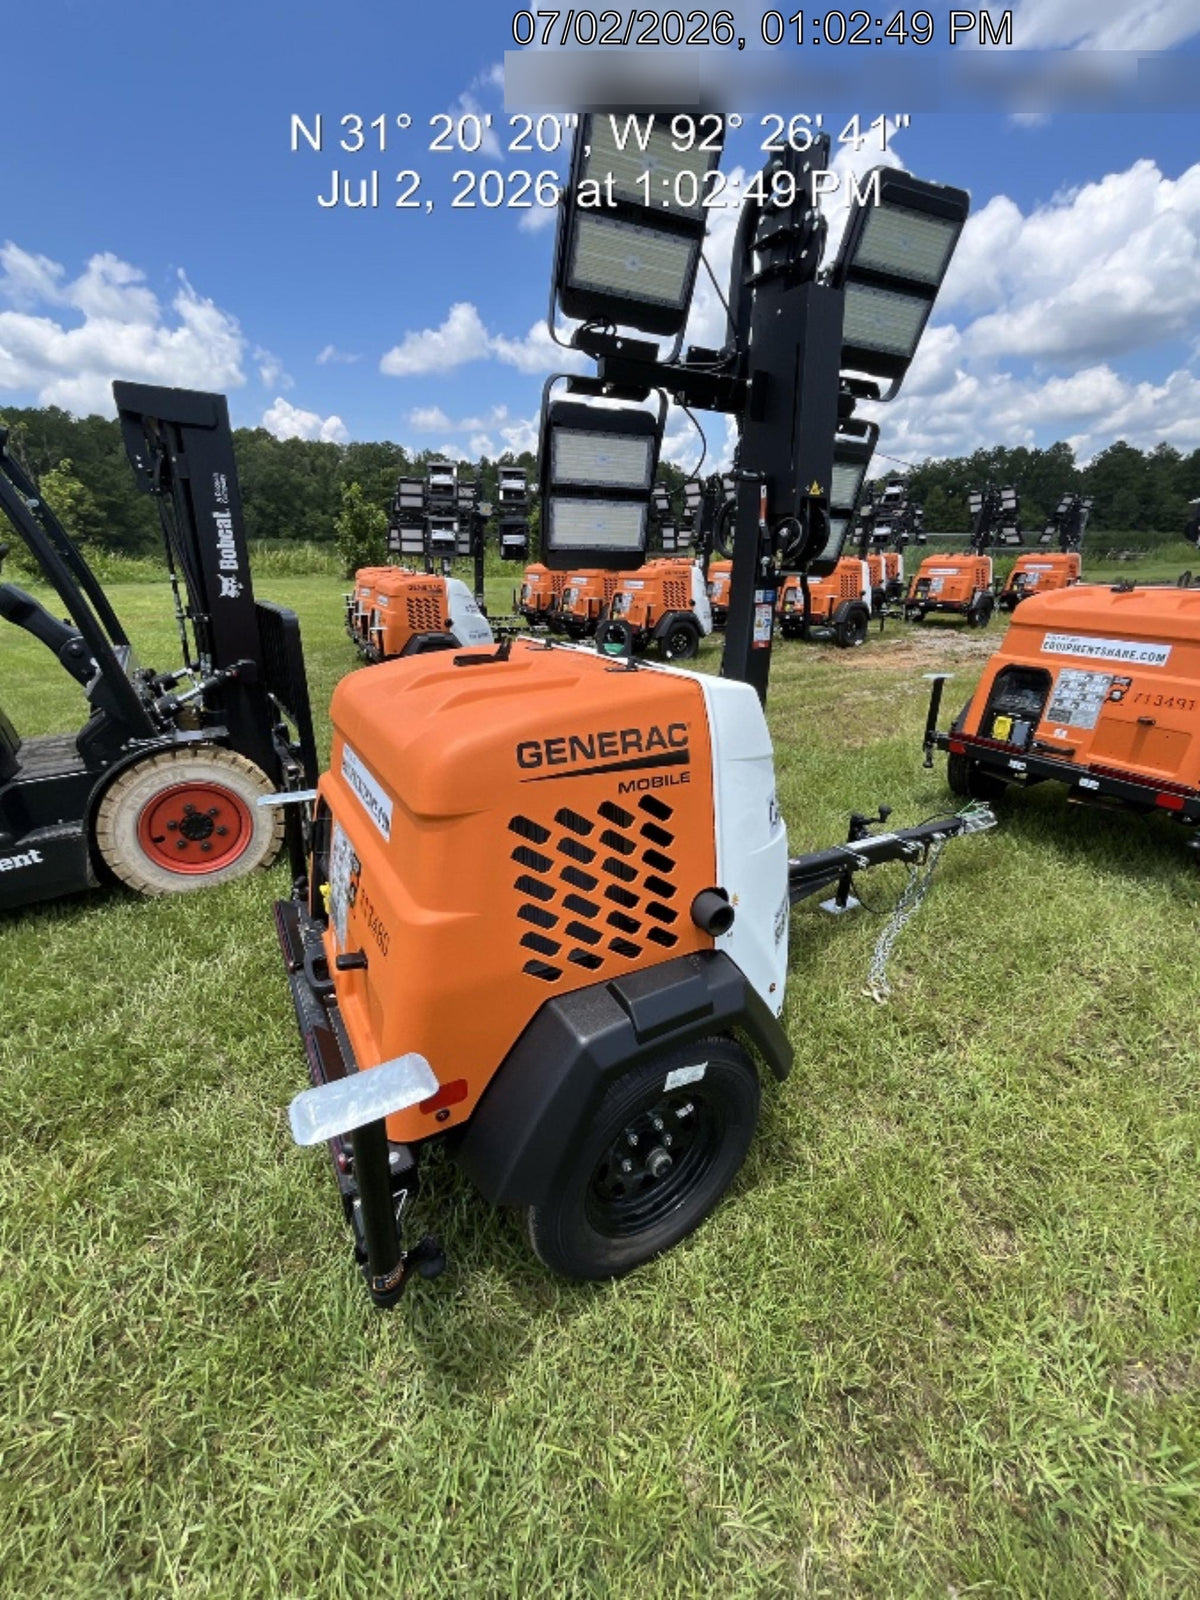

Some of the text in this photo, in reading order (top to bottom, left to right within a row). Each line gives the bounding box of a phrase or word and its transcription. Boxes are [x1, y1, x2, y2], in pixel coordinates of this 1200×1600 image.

[212, 511, 239, 570] Bobcat
[1043, 640, 1167, 663] EQUIPMENTSHARE.COM
[516, 722, 690, 769] GENERAC
[618, 771, 691, 795] MOBILE
[0, 849, 44, 871] ent
